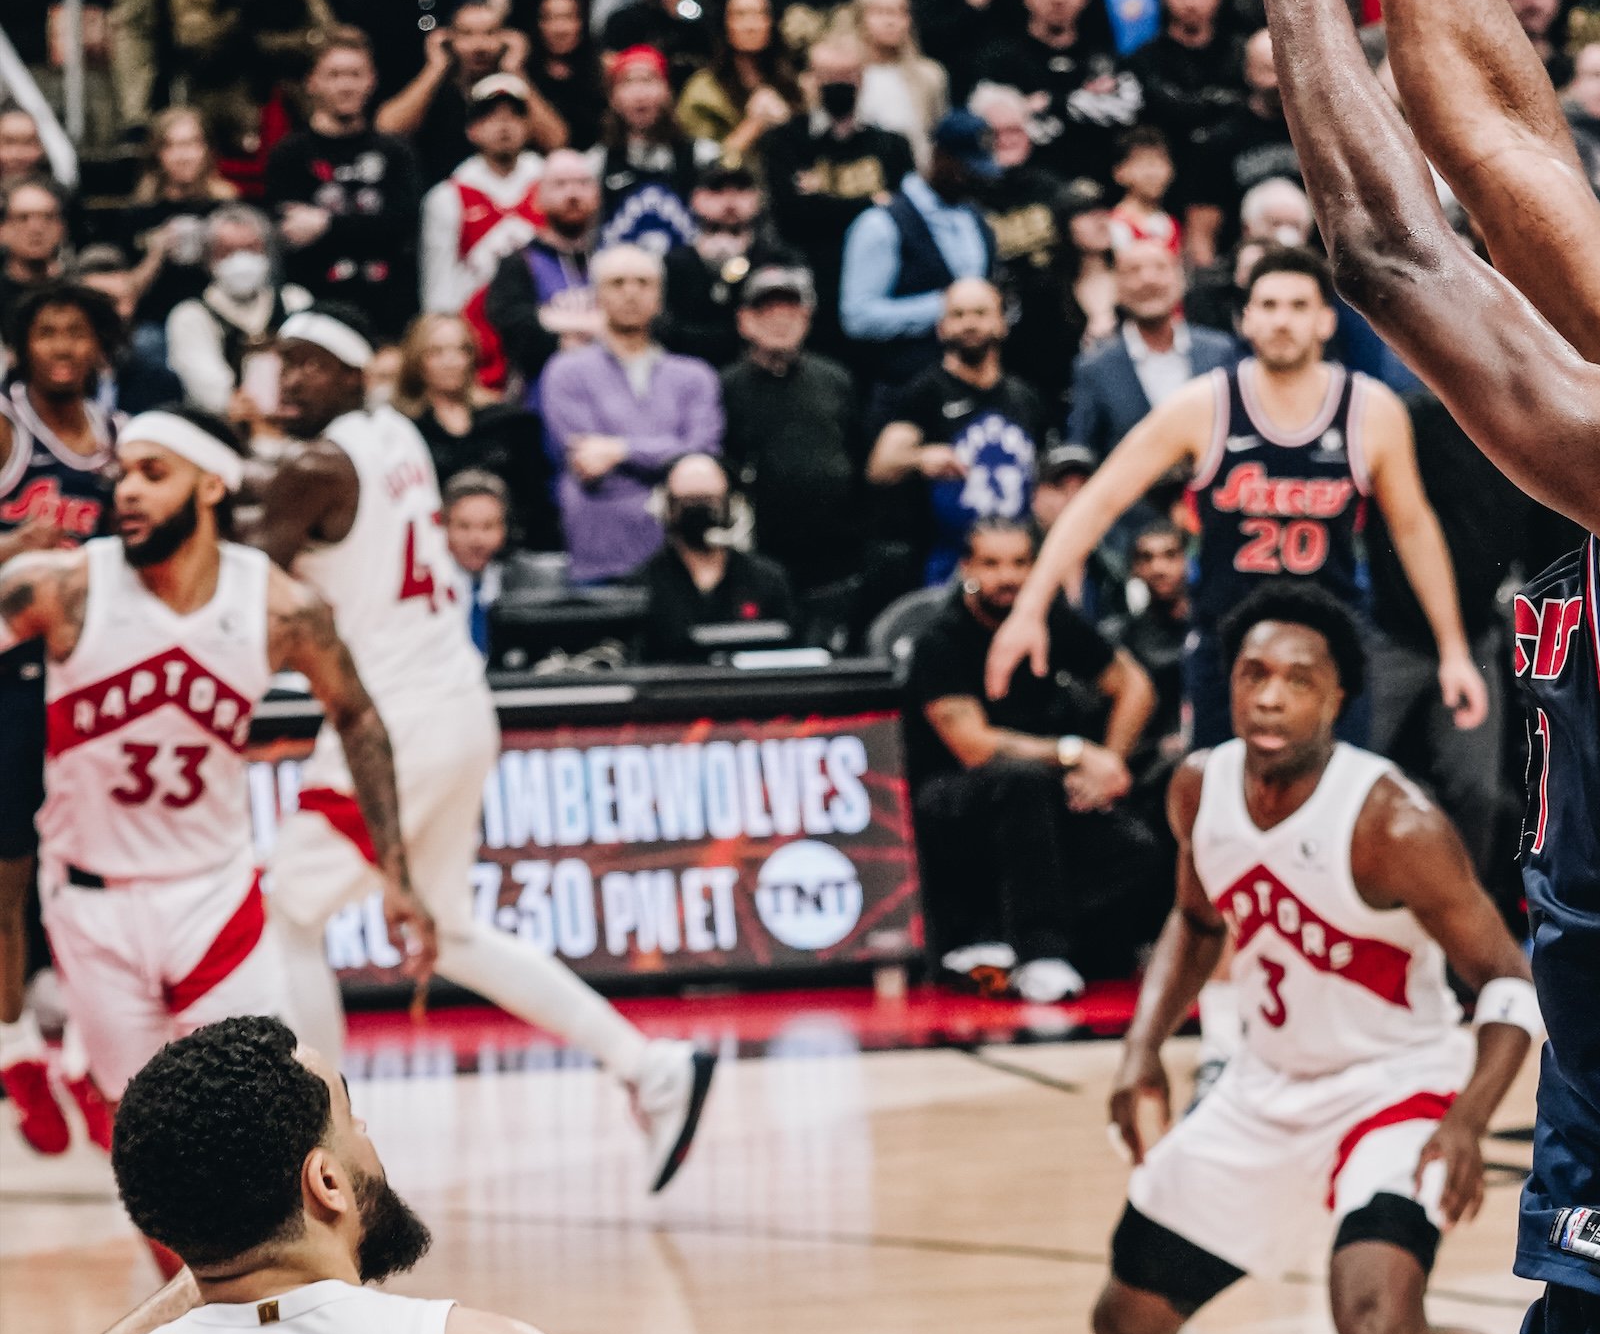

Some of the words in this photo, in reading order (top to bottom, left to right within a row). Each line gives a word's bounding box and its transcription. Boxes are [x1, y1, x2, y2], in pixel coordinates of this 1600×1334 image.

[1234, 517, 1330, 576] 20
[111, 743, 209, 808] 33
[482, 735, 872, 849] IMBERWOLVES
[681, 866, 740, 951] ET
[770, 882, 855, 917] TNT
[1258, 955, 1287, 1028] 3
